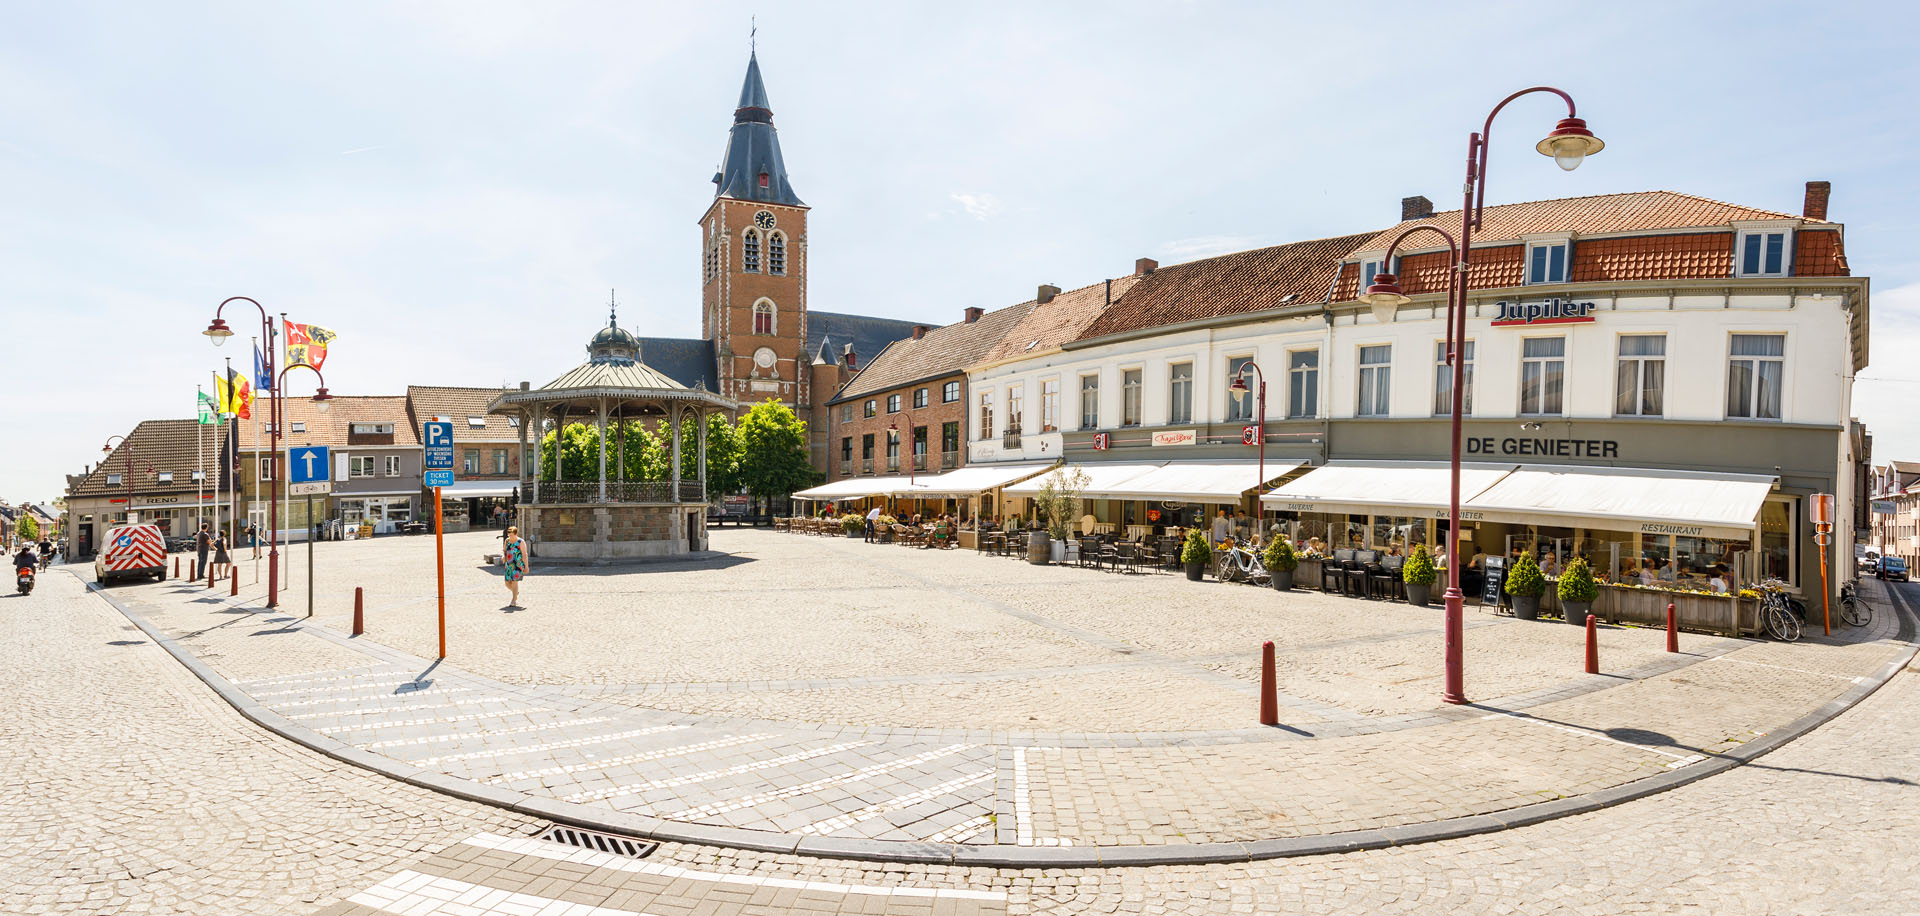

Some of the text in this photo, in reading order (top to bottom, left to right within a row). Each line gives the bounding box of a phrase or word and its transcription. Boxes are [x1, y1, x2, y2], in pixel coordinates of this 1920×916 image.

[1494, 298, 1596, 324] Jupiler
[429, 424, 443, 445] P
[1467, 437, 1618, 457] DE GENIETER
[1288, 503, 1314, 511] TAVERNE
[1436, 510, 1445, 518] De
[1641, 523, 1703, 535] RESTAURANT
